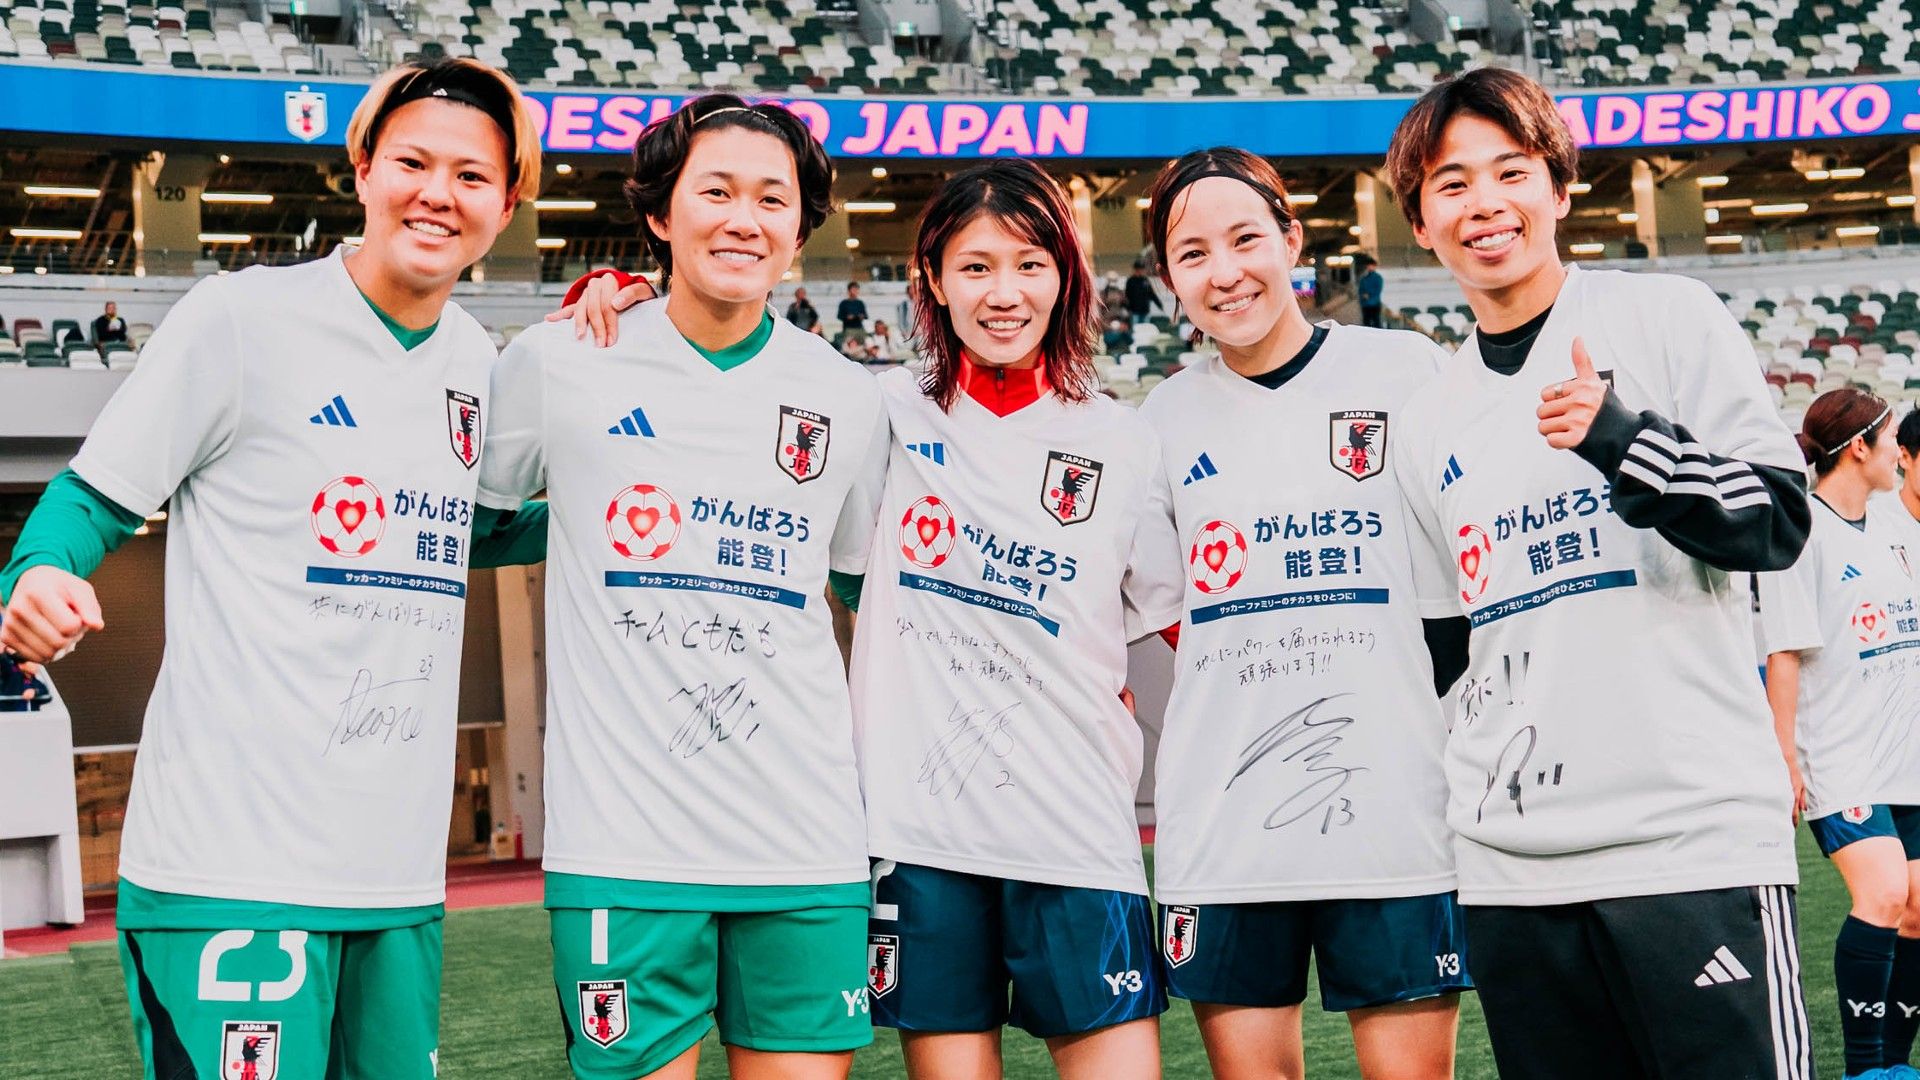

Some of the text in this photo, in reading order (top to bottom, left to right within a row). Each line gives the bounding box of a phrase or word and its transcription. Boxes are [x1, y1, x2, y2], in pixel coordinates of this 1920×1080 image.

[841, 102, 1089, 155] JAPAN
[1554, 83, 1892, 149] ADESHIKO
[791, 408, 821, 422] JAPAN
[1343, 411, 1376, 420] JAPAN
[789, 457, 811, 474] JFA
[1060, 454, 1092, 468] JAPAN
[1345, 457, 1371, 471] JFA
[690, 495, 810, 543] がんばろう
[1054, 500, 1078, 517] JFA
[1253, 508, 1383, 543] がんばろう
[416, 530, 466, 568] 能登!
[717, 536, 787, 577] 能登!
[961, 523, 1078, 583] がんばろう
[1284, 545, 1363, 580] 能登!
[1526, 526, 1602, 577] 能登!
[638, 574, 780, 600] サッカーファミリーのチカラをひとつに!
[1218, 592, 1357, 615] サッカーファミリーのチカラをひとつに!
[613, 609, 777, 659] チームともだち
[994, 769, 1017, 789] 2
[1320, 797, 1356, 836] 13
[1434, 952, 1461, 978] Y-3
[1102, 970, 1144, 996] Y-3
[841, 987, 870, 1017] Y-3
[1847, 998, 1887, 1019] Y-3
